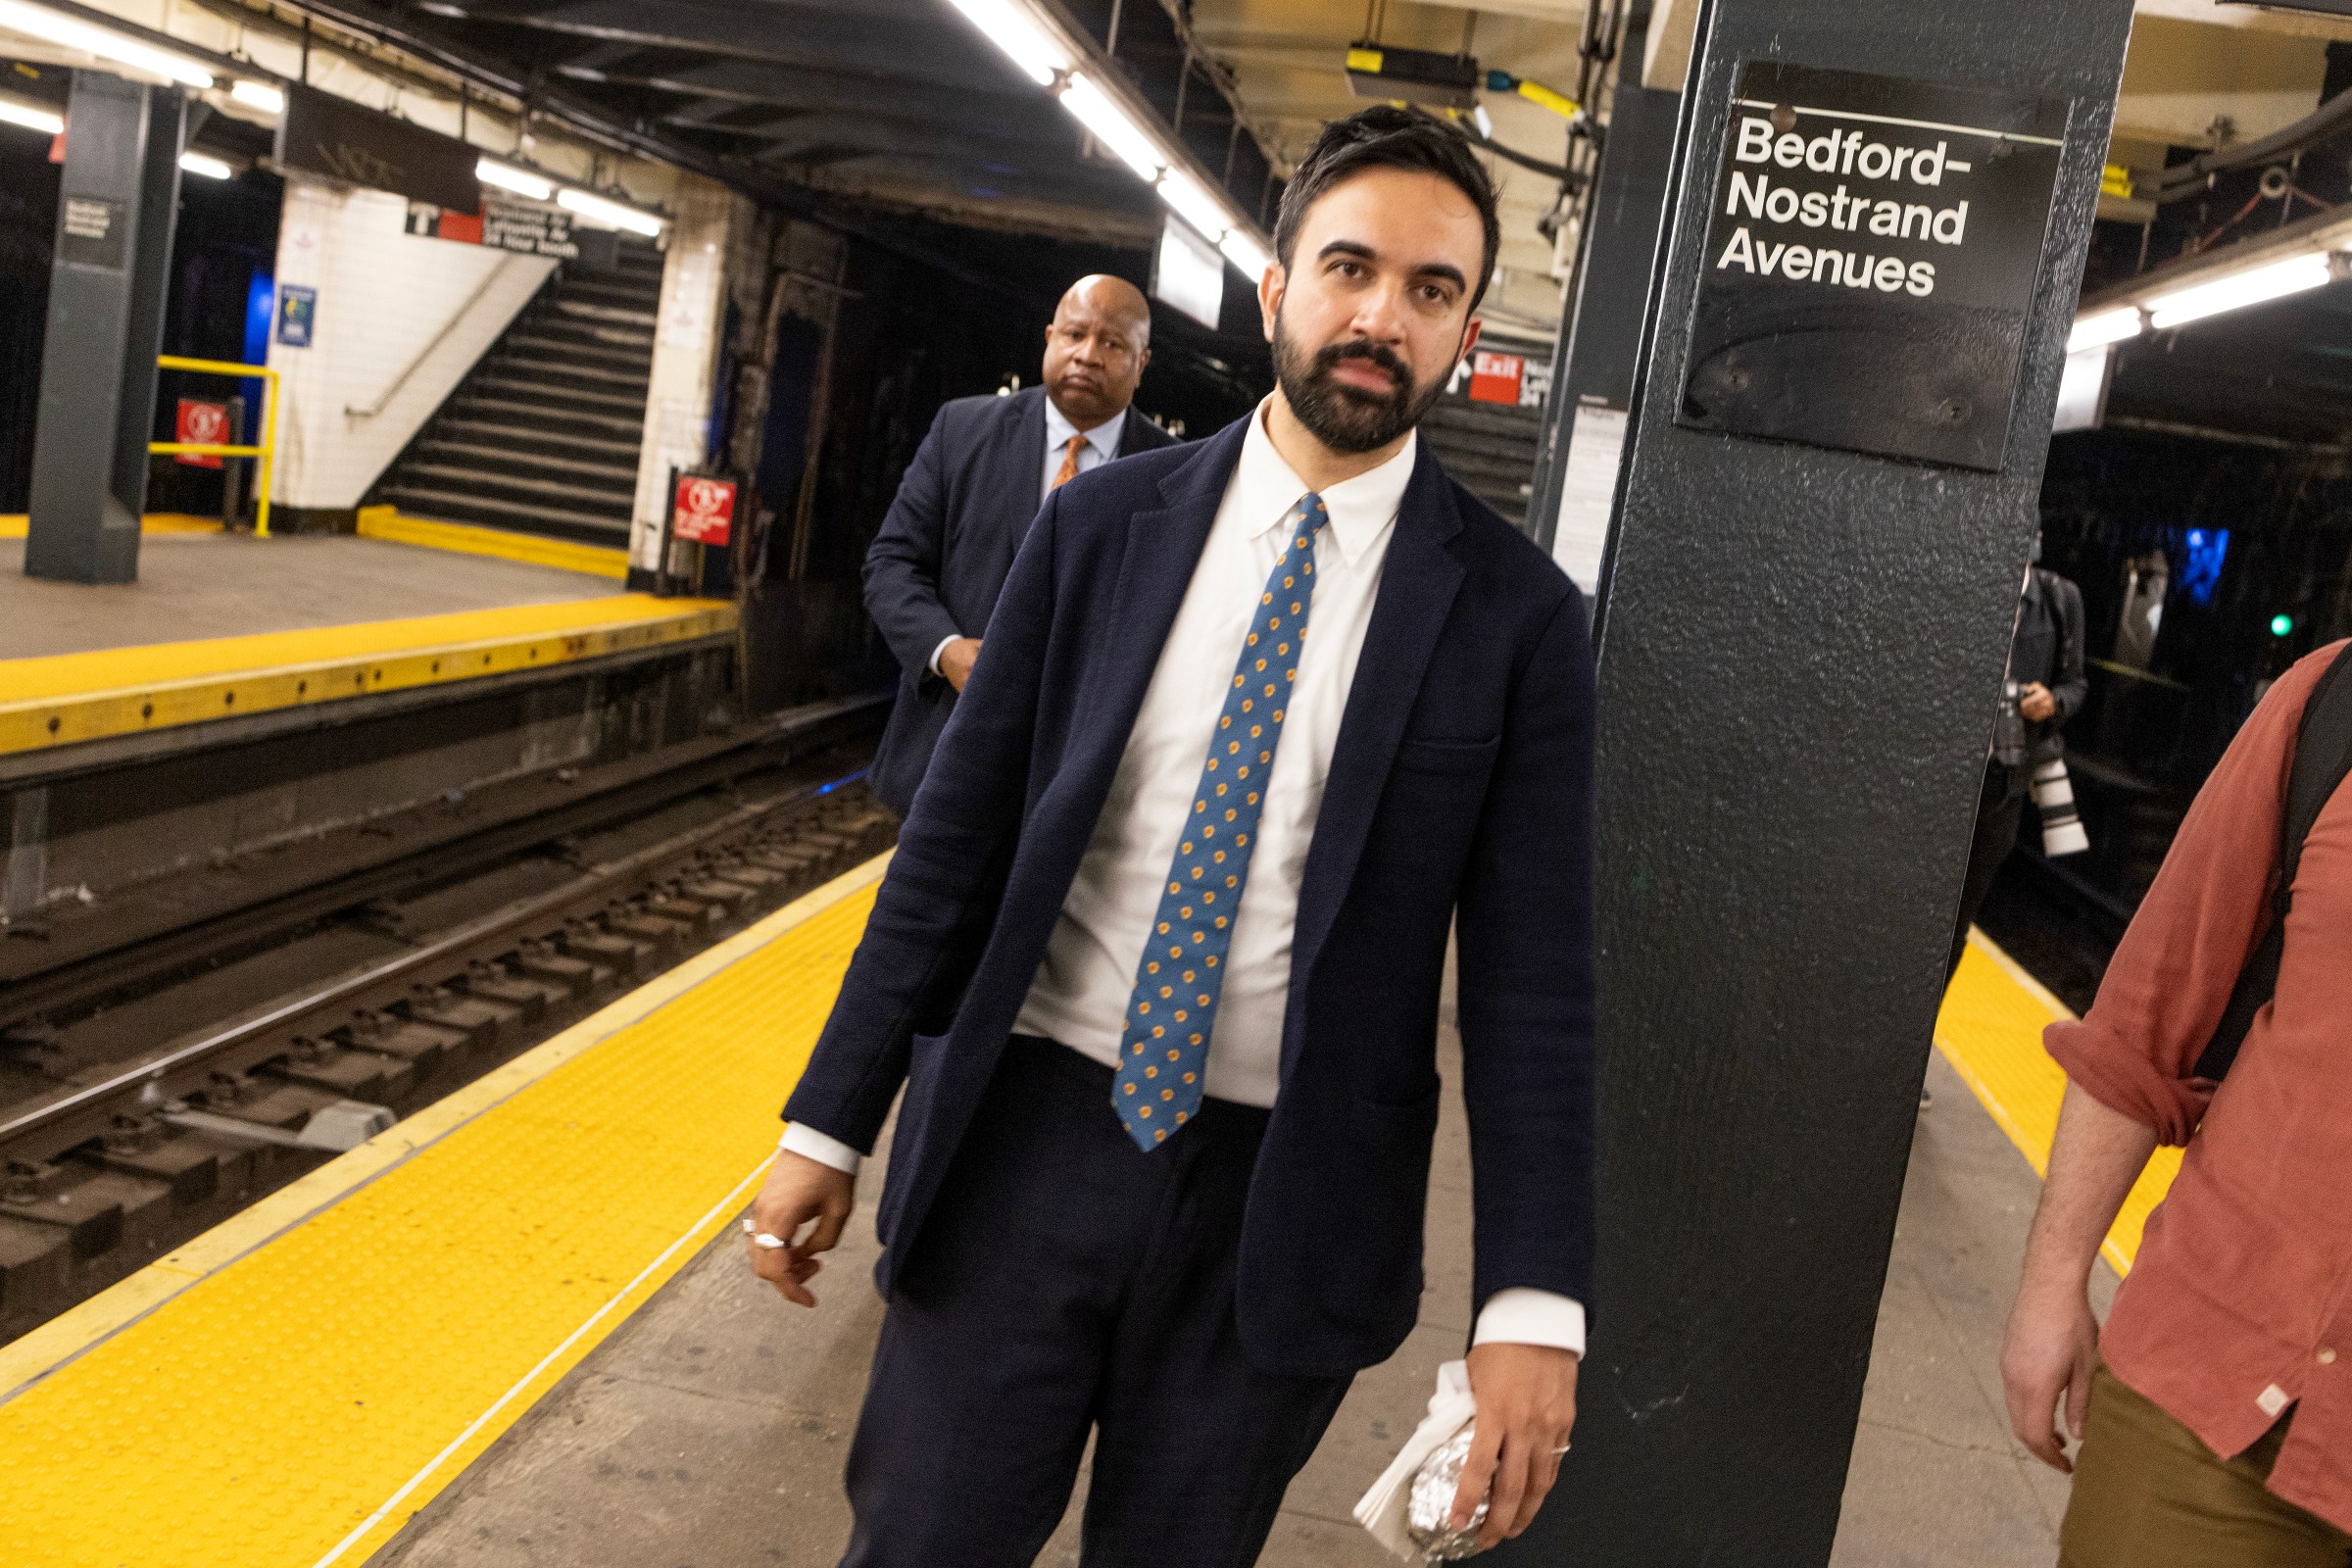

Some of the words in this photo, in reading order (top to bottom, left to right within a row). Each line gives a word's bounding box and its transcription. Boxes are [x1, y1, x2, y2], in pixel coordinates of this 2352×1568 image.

[1735, 116, 1972, 186] Bedford-
[1726, 171, 1970, 246] Nostrand
[1716, 226, 1936, 297] Avenues
[1474, 352, 1519, 380] Exit
